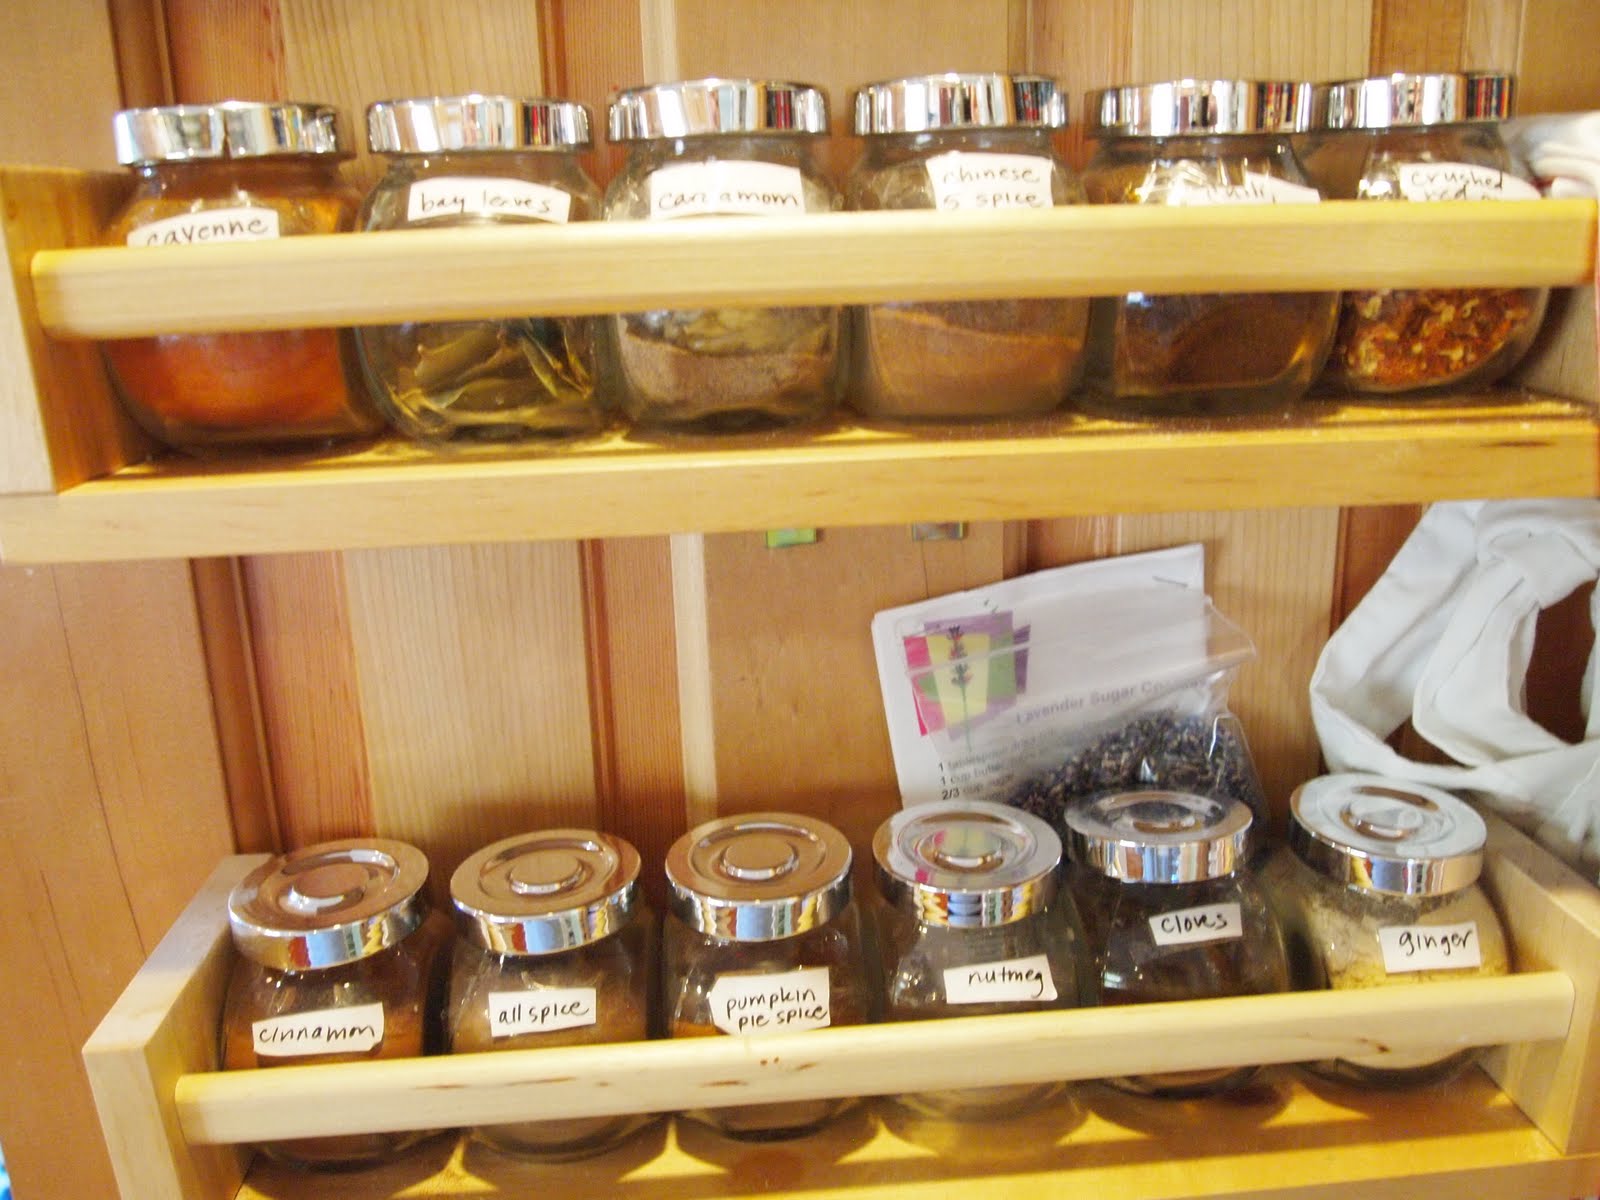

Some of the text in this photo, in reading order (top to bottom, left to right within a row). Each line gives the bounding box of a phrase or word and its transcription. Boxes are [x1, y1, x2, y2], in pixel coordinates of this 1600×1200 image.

[421, 189, 551, 214] bay leaves
[147, 217, 269, 246] cayenne
[1015, 698, 1084, 725] Lavender
[1089, 685, 1137, 705] Sugar
[941, 786, 961, 801] 2/3
[1160, 914, 1228, 935] cloves
[1398, 928, 1474, 957] ginger
[967, 966, 1045, 999] nutmeg
[726, 985, 817, 1020] pumpkin
[258, 1024, 376, 1043] cinnamon
[738, 1004, 828, 1034] pie spice
